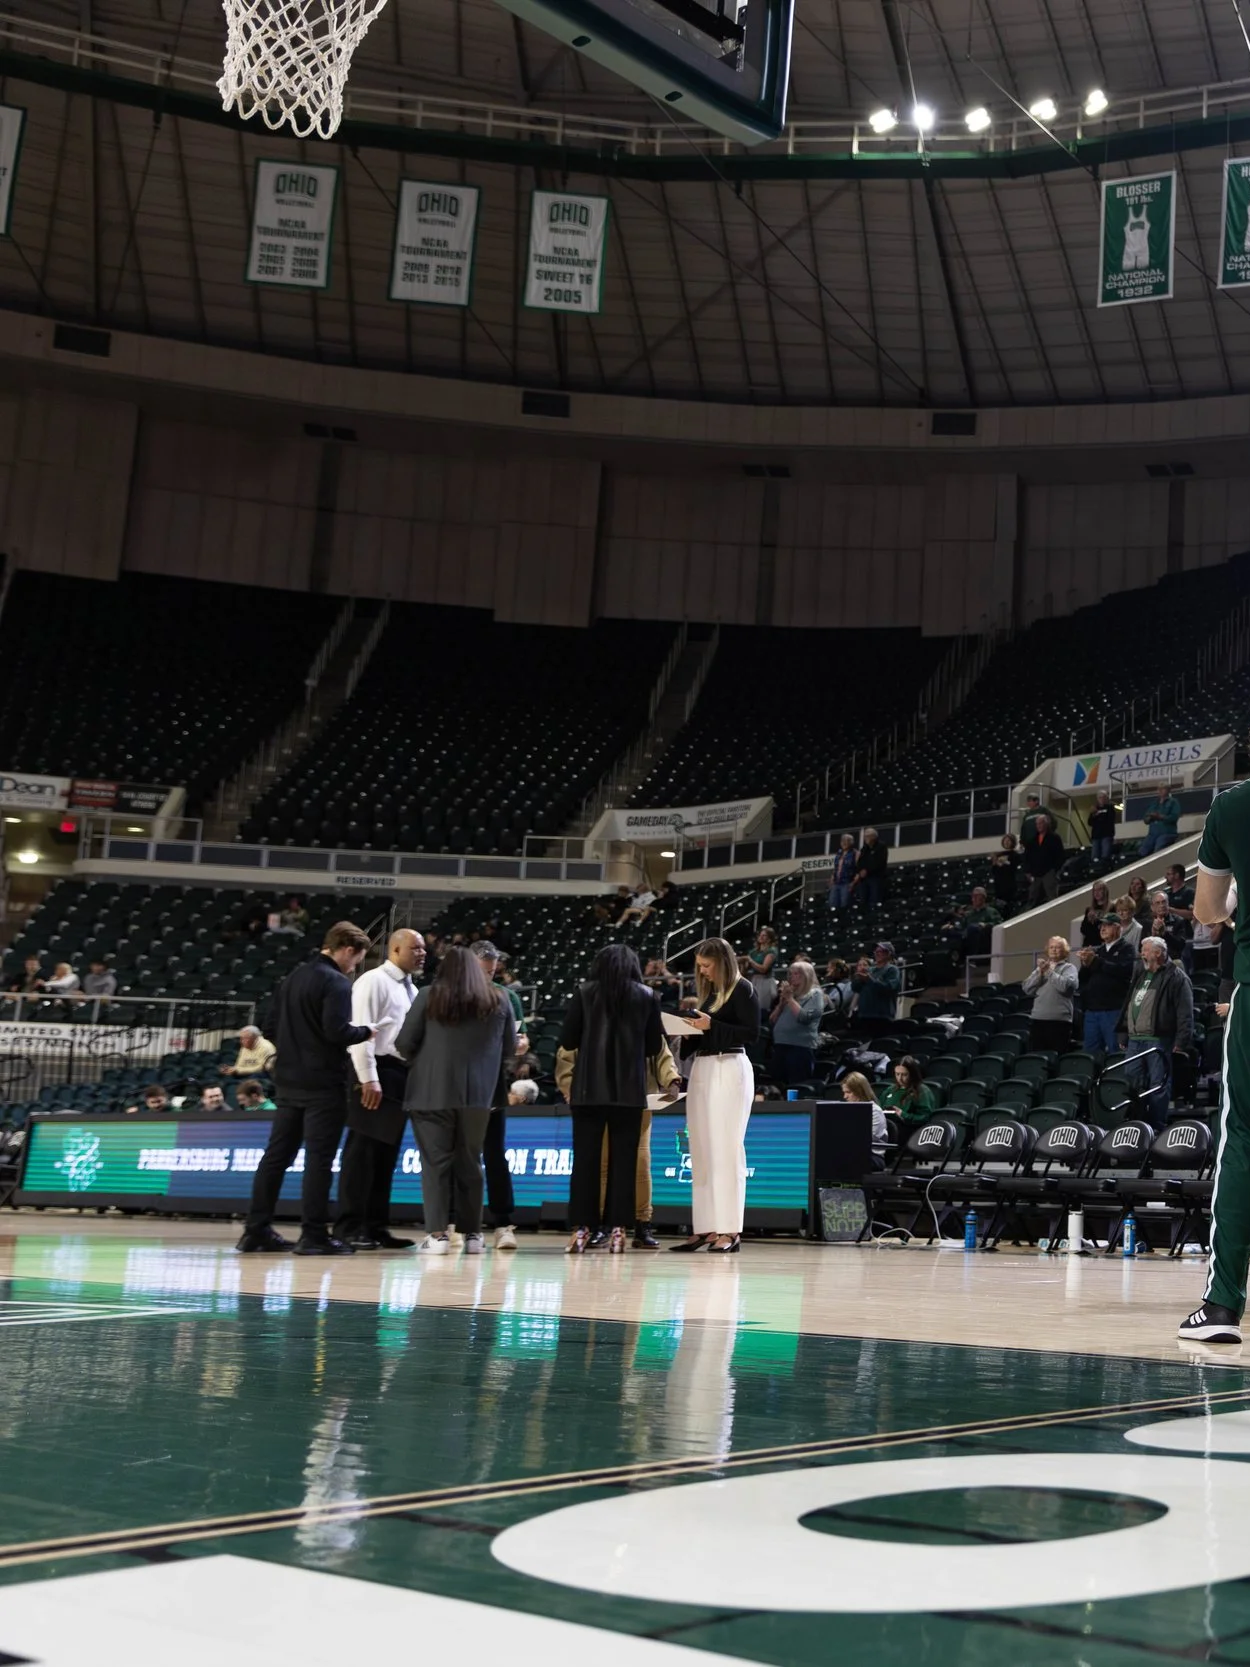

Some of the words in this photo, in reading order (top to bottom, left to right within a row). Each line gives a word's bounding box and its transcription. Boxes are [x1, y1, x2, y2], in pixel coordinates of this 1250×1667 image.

[275, 173, 318, 197] OHIO
[1116, 181, 1161, 198] BLOSSER
[417, 192, 459, 217] OHIO
[549, 203, 589, 227] OHIO
[256, 225, 325, 241] TOURNAMENT
[400, 245, 467, 261] TOURNAMENT
[553, 246, 579, 257] NCAA
[533, 254, 597, 268] TOURNAMENT
[535, 270, 575, 282] SWEET
[579, 274, 593, 285] 16
[1105, 275, 1165, 290] CHAMPION
[1108, 267, 1163, 282] NATIONAL
[544, 287, 582, 304] 2005
[1118, 285, 1153, 298] 1932
[1107, 744, 1202, 770] LAURELS
[0, 777, 56, 795] Dean
[627, 816, 669, 827] GAMEDAY
[802, 858, 834, 869] RESERV
[337, 876, 396, 886] RESERVED
[919, 1126, 944, 1147] OHIO
[985, 1126, 1014, 1147] OHIO
[1048, 1126, 1077, 1148] OHIO
[1112, 1126, 1140, 1148] OHIO
[1167, 1126, 1197, 1148] OHIO
